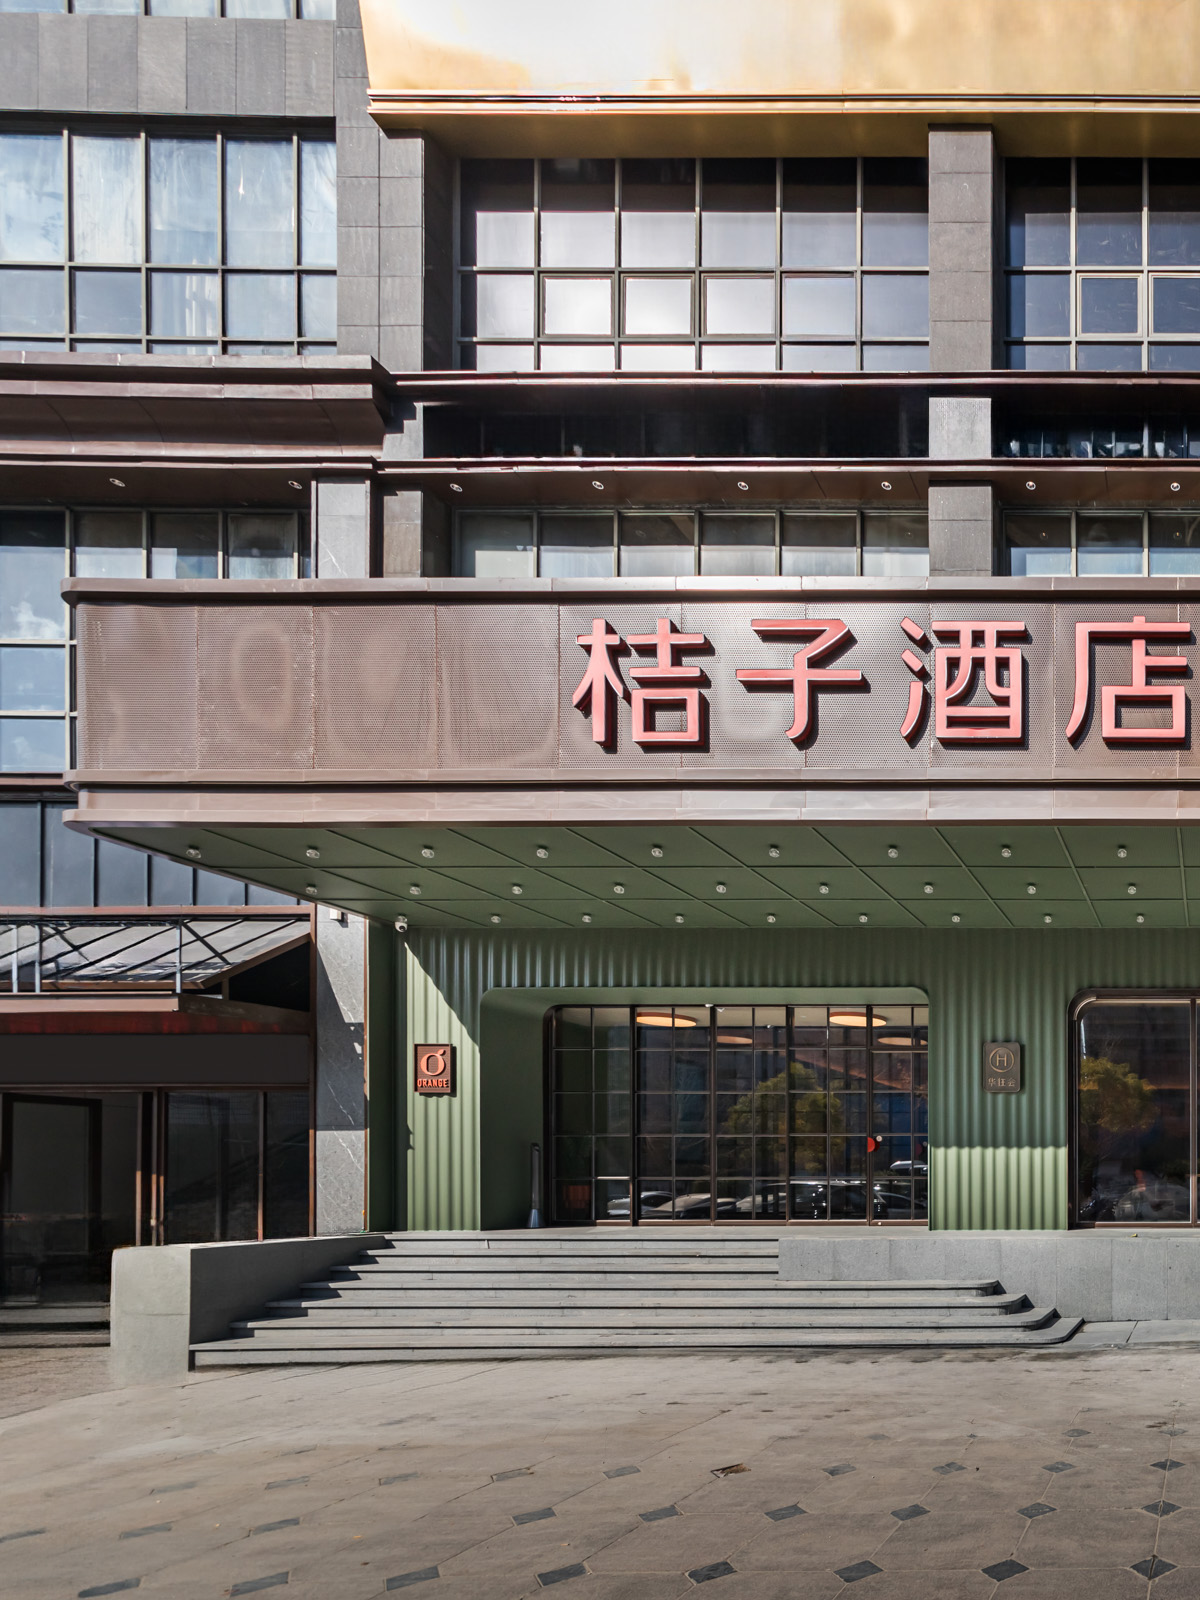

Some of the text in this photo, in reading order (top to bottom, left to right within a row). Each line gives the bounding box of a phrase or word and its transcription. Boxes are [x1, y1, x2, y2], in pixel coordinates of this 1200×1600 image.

[572, 616, 1192, 745] 桔子酒店
[417, 1078, 448, 1088] ORANGE
